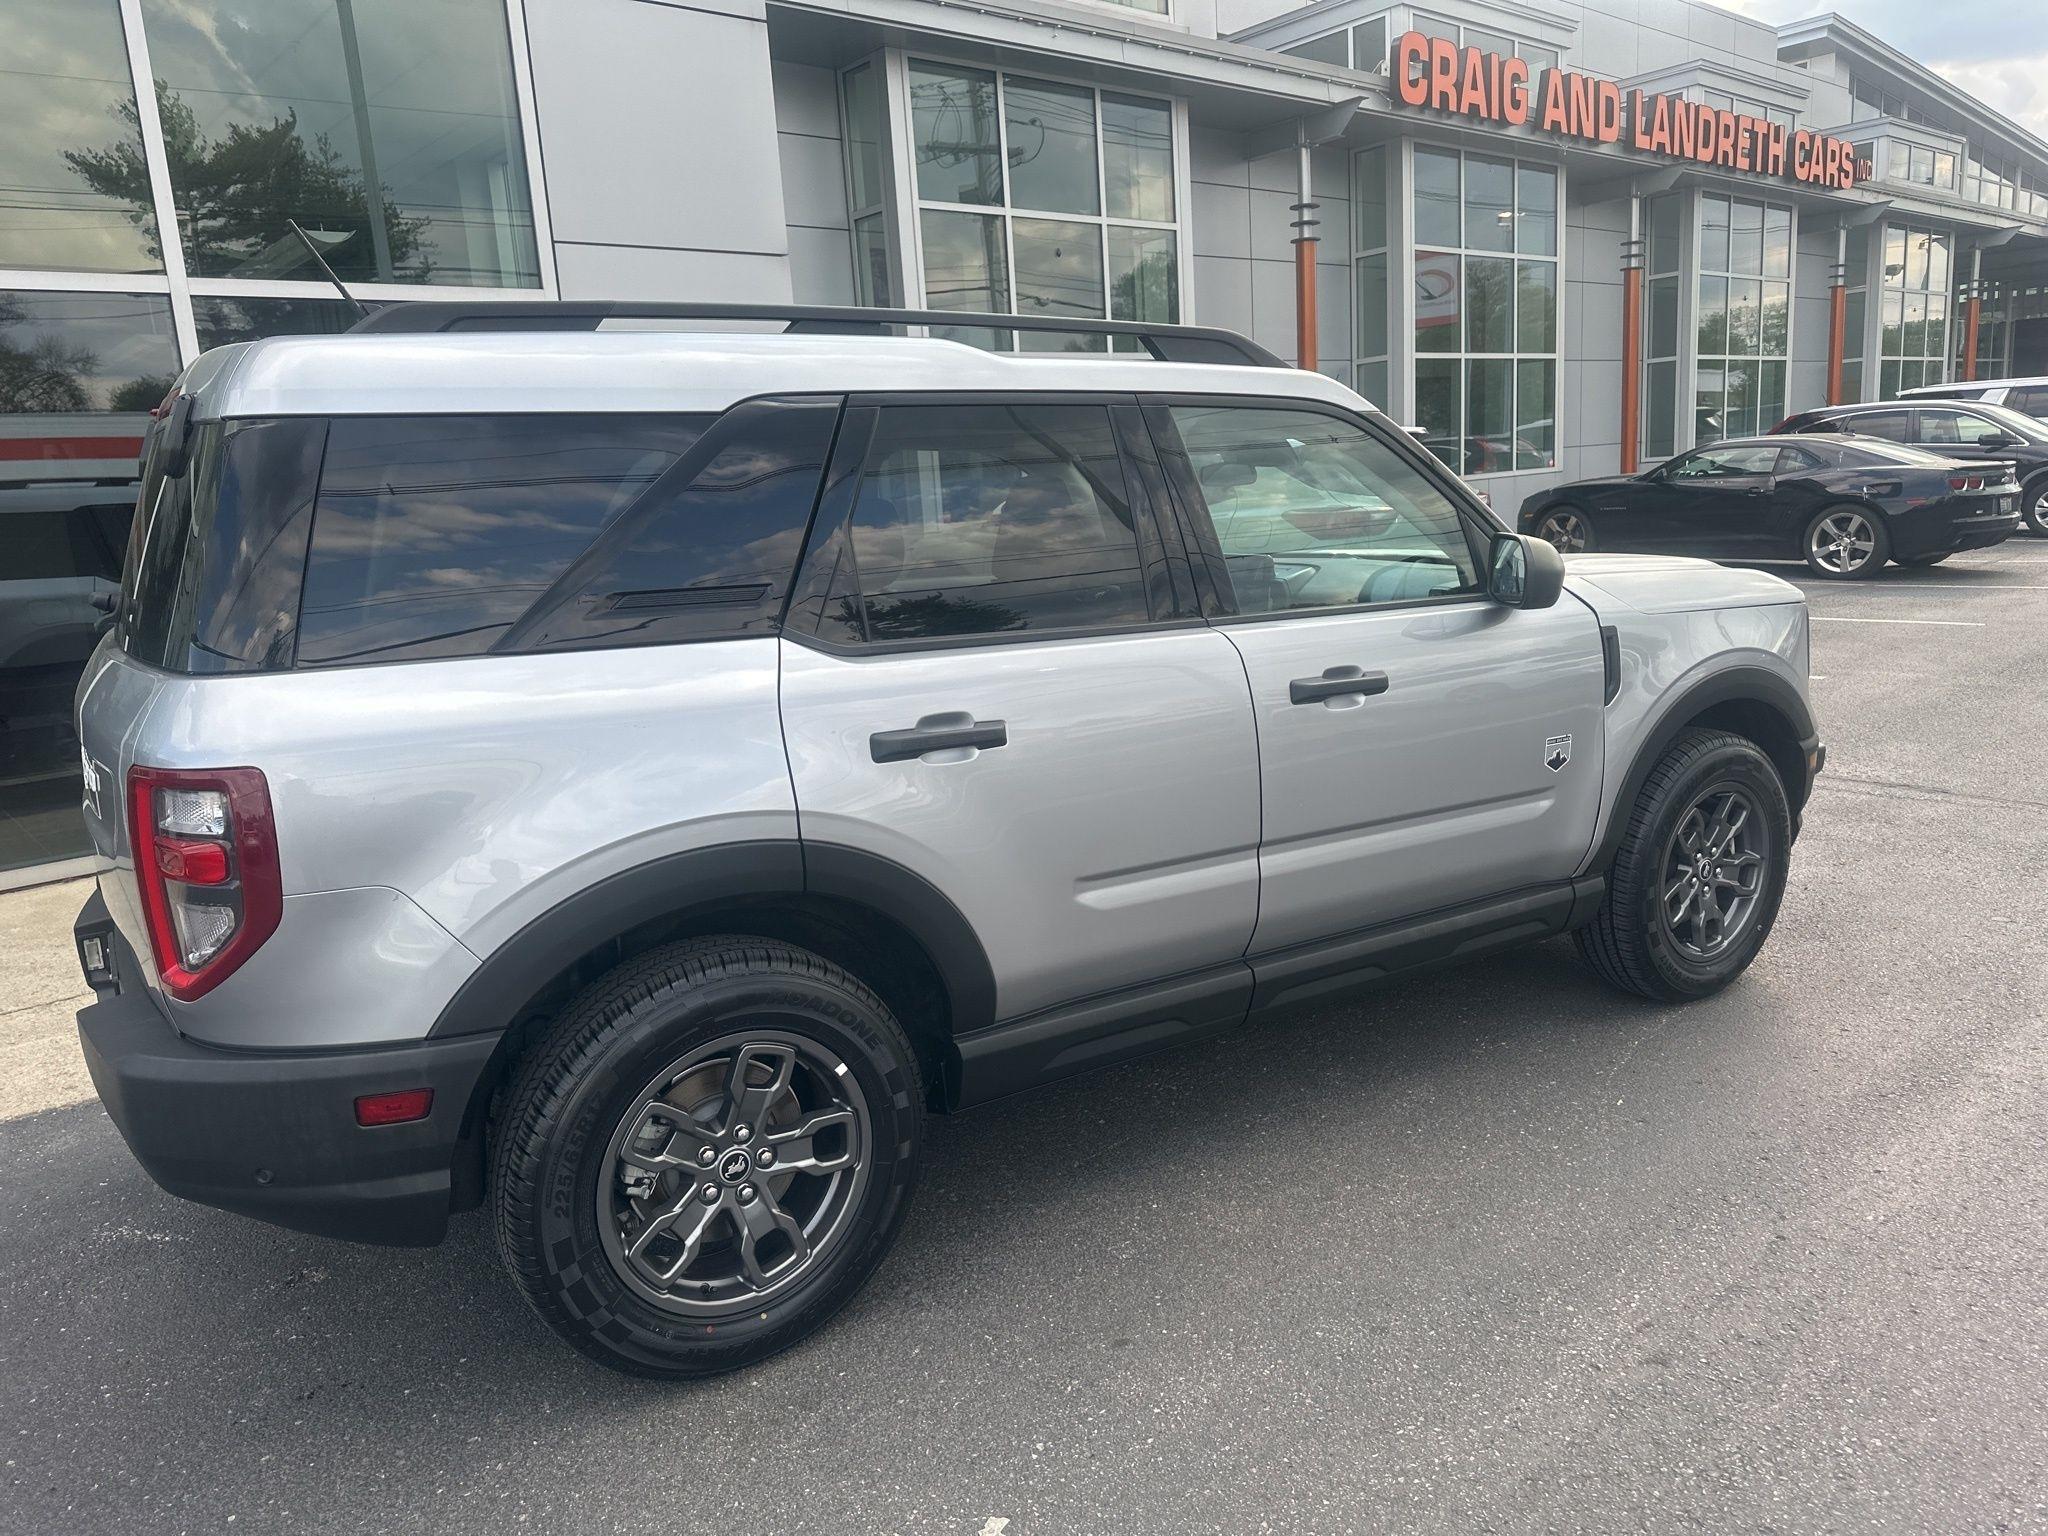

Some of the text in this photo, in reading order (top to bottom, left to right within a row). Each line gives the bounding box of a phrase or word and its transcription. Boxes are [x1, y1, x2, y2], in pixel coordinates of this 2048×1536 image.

[1398, 31, 1529, 125] CRAIG
[1542, 67, 1621, 143] AND
[1634, 89, 1786, 176] LANDRETH
[1794, 129, 1855, 190] CARS
